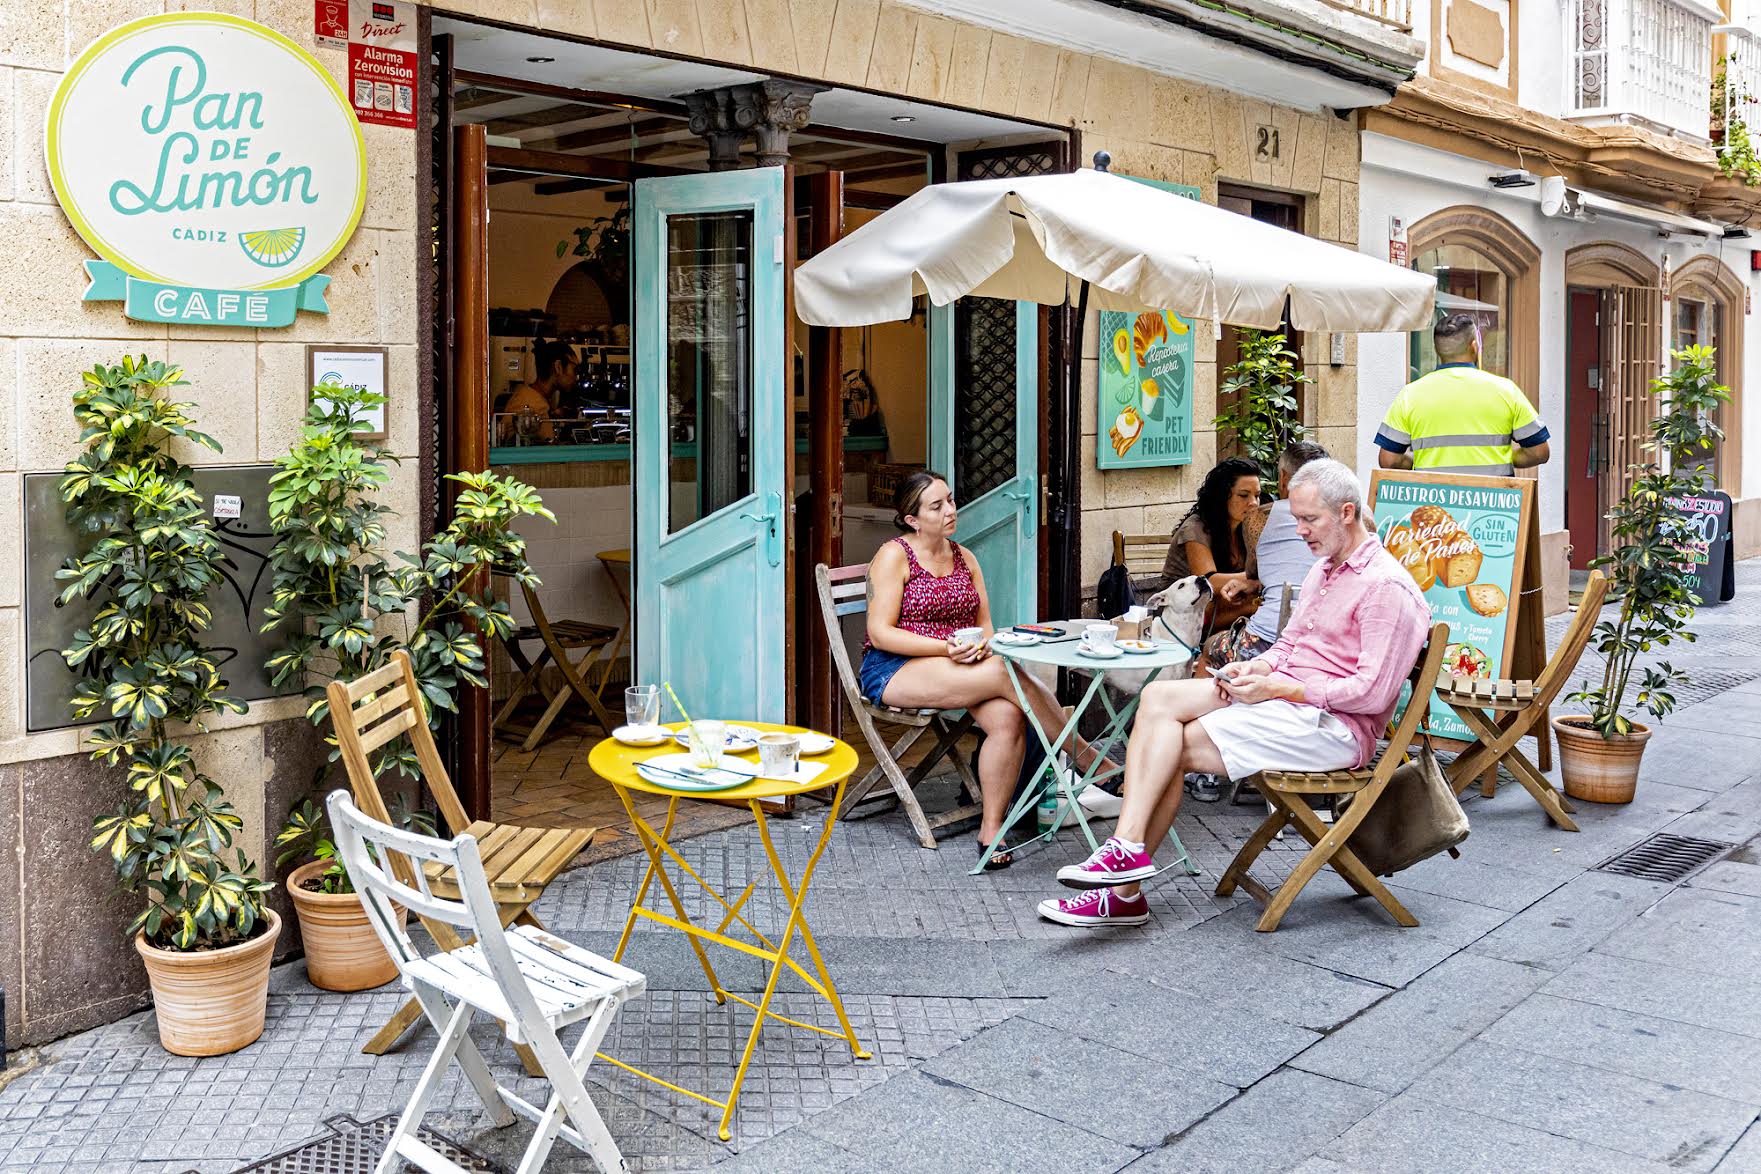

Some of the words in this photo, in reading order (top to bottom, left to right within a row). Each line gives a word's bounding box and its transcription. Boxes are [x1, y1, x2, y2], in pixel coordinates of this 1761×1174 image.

[360, 22, 407, 38] Direct
[364, 47, 404, 64] Alarma
[354, 59, 413, 78] Zerovision
[121, 46, 264, 135] Pan
[210, 137, 251, 161] DE
[1257, 127, 1280, 159] 21
[109, 132, 319, 215] Limón
[172, 228, 227, 243] CADIZ
[154, 290, 270, 323] CAFÉ
[1152, 360, 1179, 377] casera
[1165, 416, 1183, 434] PET
[1141, 435, 1188, 457] FRIENDLY
[1380, 484, 1446, 505] NUESTROS
[1449, 490, 1521, 509] DESAYUNOS
[1376, 512, 1472, 547] Variedad
[1485, 519, 1506, 531] SIN
[1399, 547, 1420, 566] de
[1420, 537, 1475, 564] Panes
[1443, 605, 1459, 616] con
[1443, 717, 1475, 736] Zumo
